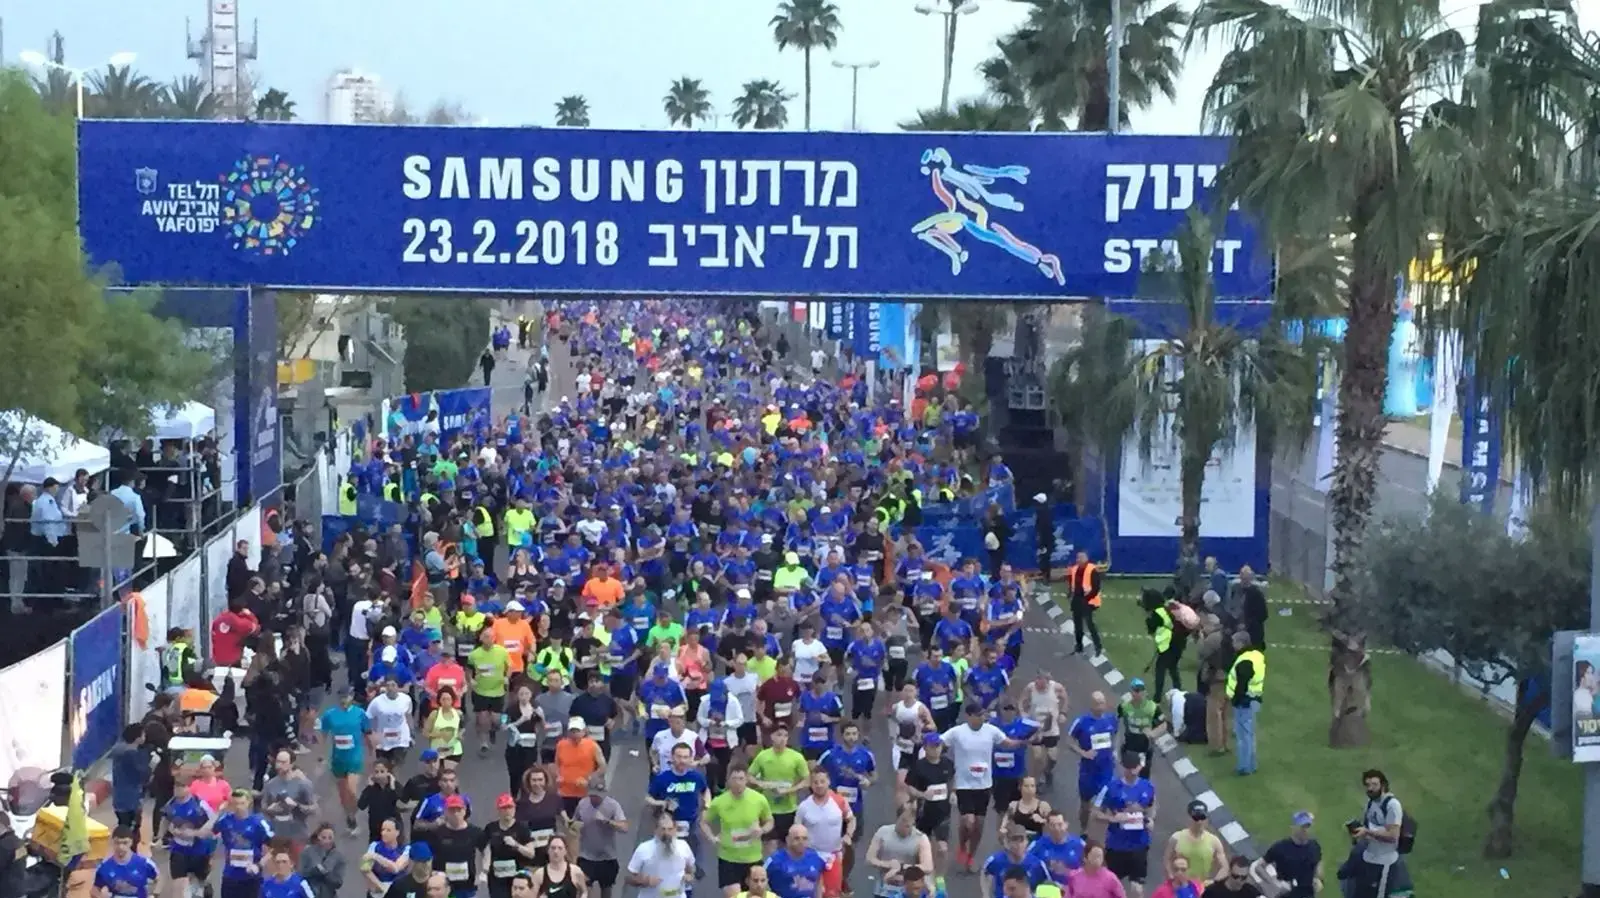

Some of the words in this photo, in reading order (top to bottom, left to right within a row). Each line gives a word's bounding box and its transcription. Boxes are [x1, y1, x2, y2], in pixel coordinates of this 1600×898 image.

[168, 183, 196, 199] TEL
[195, 180, 220, 199] תל
[402, 155, 684, 203] SAMSUNG
[700, 159, 858, 214] מרתון
[1105, 163, 1240, 222] ינוק
[142, 200, 179, 216] AVIV
[178, 200, 220, 216] אביב
[155, 217, 197, 233] YAFO
[197, 217, 220, 232] יפו
[402, 217, 620, 266] 23.2.2018
[1103, 238, 1242, 273] STAT
